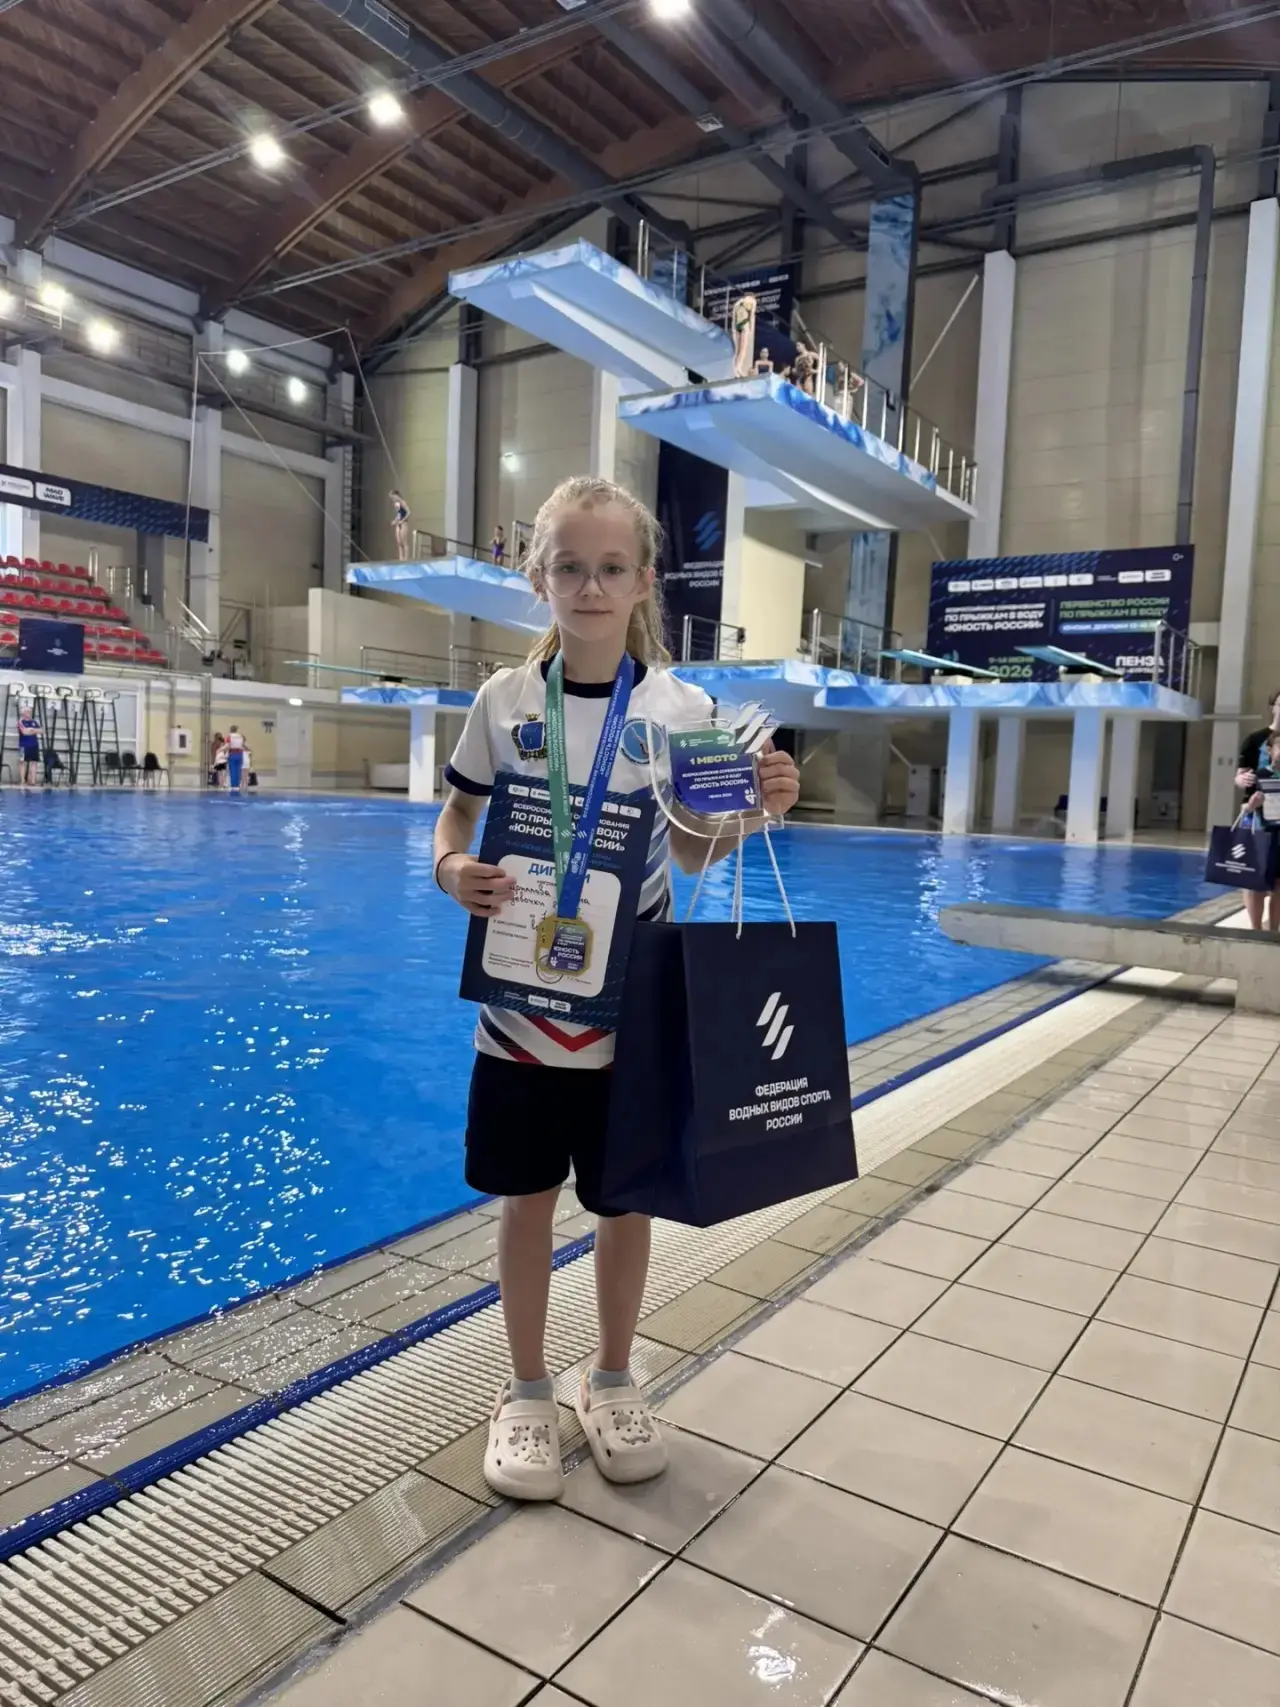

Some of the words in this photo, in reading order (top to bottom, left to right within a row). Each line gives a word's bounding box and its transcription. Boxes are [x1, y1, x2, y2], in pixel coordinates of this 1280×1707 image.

[944, 614, 958, 622] ПО
[959, 612, 1008, 622] ПРЫЖКАМ
[1017, 610, 1045, 619] ВОДУ
[1060, 610, 1074, 618] ПО
[1075, 608, 1128, 618] ПРЫЖКАМ
[1139, 607, 1169, 617] ВОДУ
[944, 622, 993, 632] «ЮНОСТЬ
[994, 620, 1044, 630] РОССИИ»
[697, 753, 738, 764] МЕСТО
[689, 782, 719, 790] «ЮНОСТЬ
[720, 779, 749, 787] РОССИИ»
[511, 811, 526, 821] ПО
[596, 827, 628, 840] ВОДУ
[554, 946, 580, 954] ЮНОСТЬ
[755, 1077, 808, 1097] ФЕДЕРАЦИЯ
[729, 1103, 769, 1121] ВОДНЫХ
[770, 1096, 800, 1112] ВИДОВ
[801, 1090, 831, 1105] СПОРТА
[766, 1113, 802, 1131] РОССИИ
